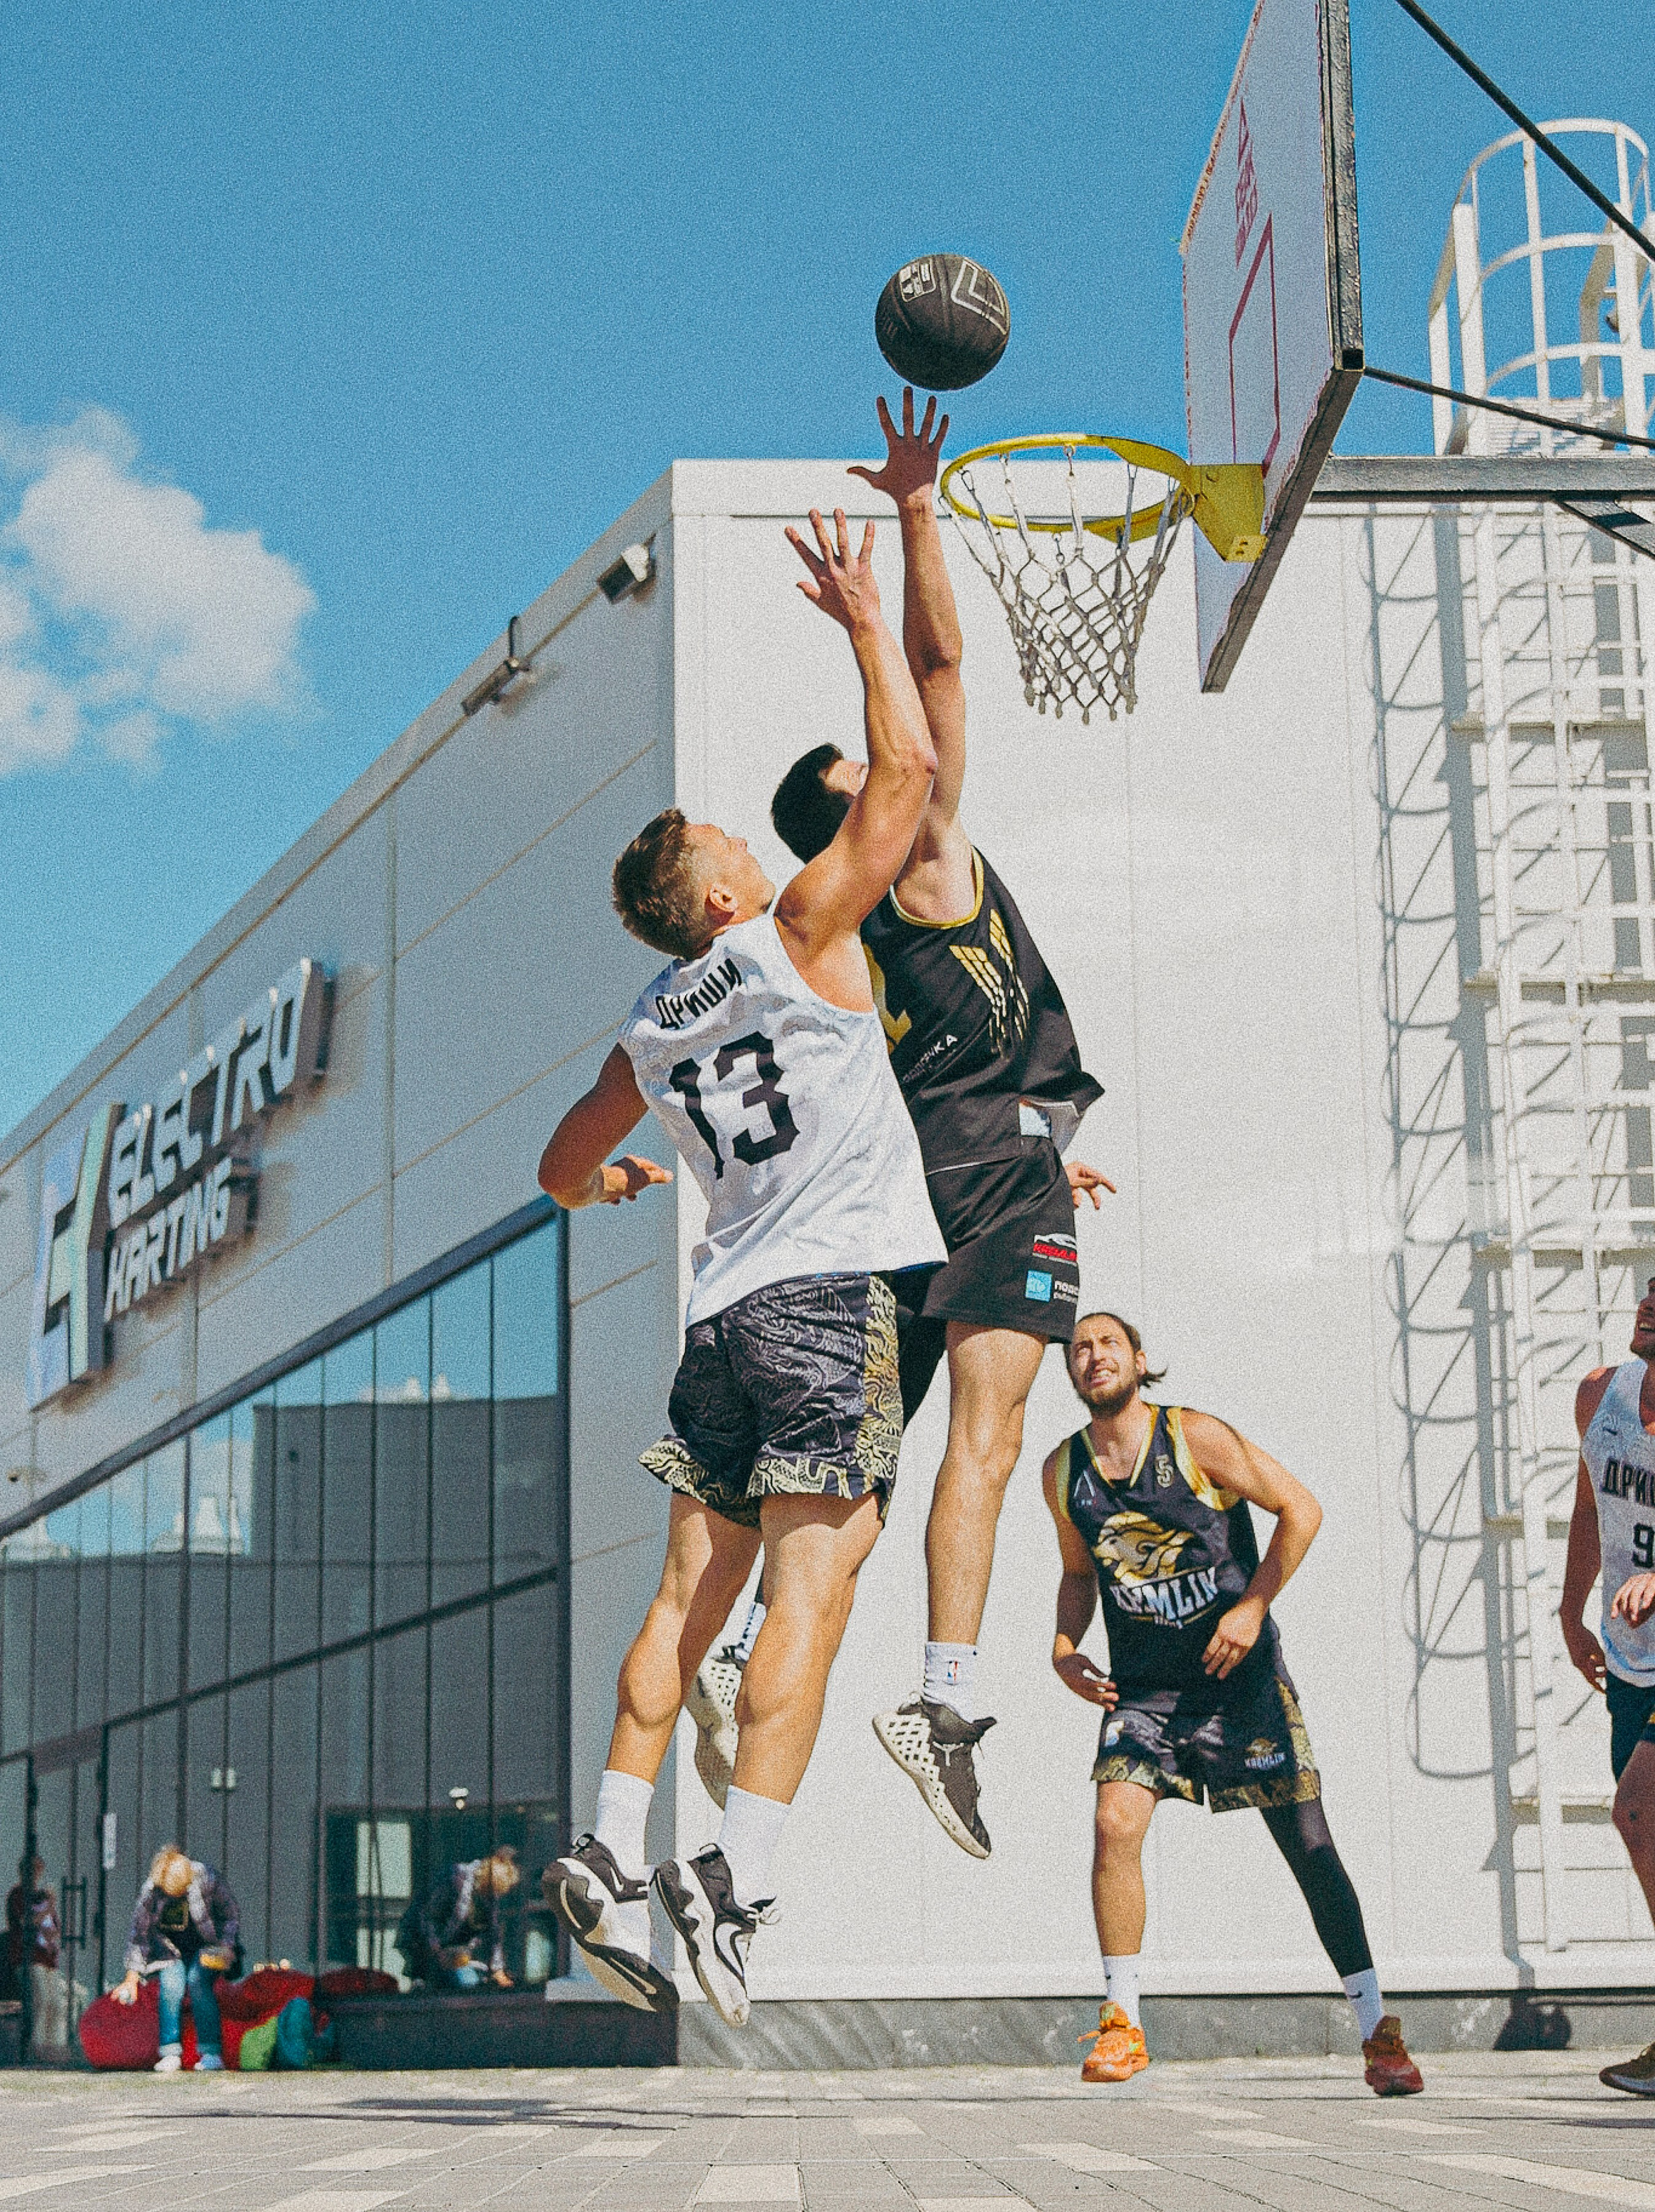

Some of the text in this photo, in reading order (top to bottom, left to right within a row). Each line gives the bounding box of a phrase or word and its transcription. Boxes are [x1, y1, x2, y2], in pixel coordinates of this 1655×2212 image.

[109, 958, 312, 1229] ELECTRO
[669, 1030, 801, 1180] 13
[103, 1156, 232, 1322] KARTING
[1631, 1522, 1655, 1569] 9
